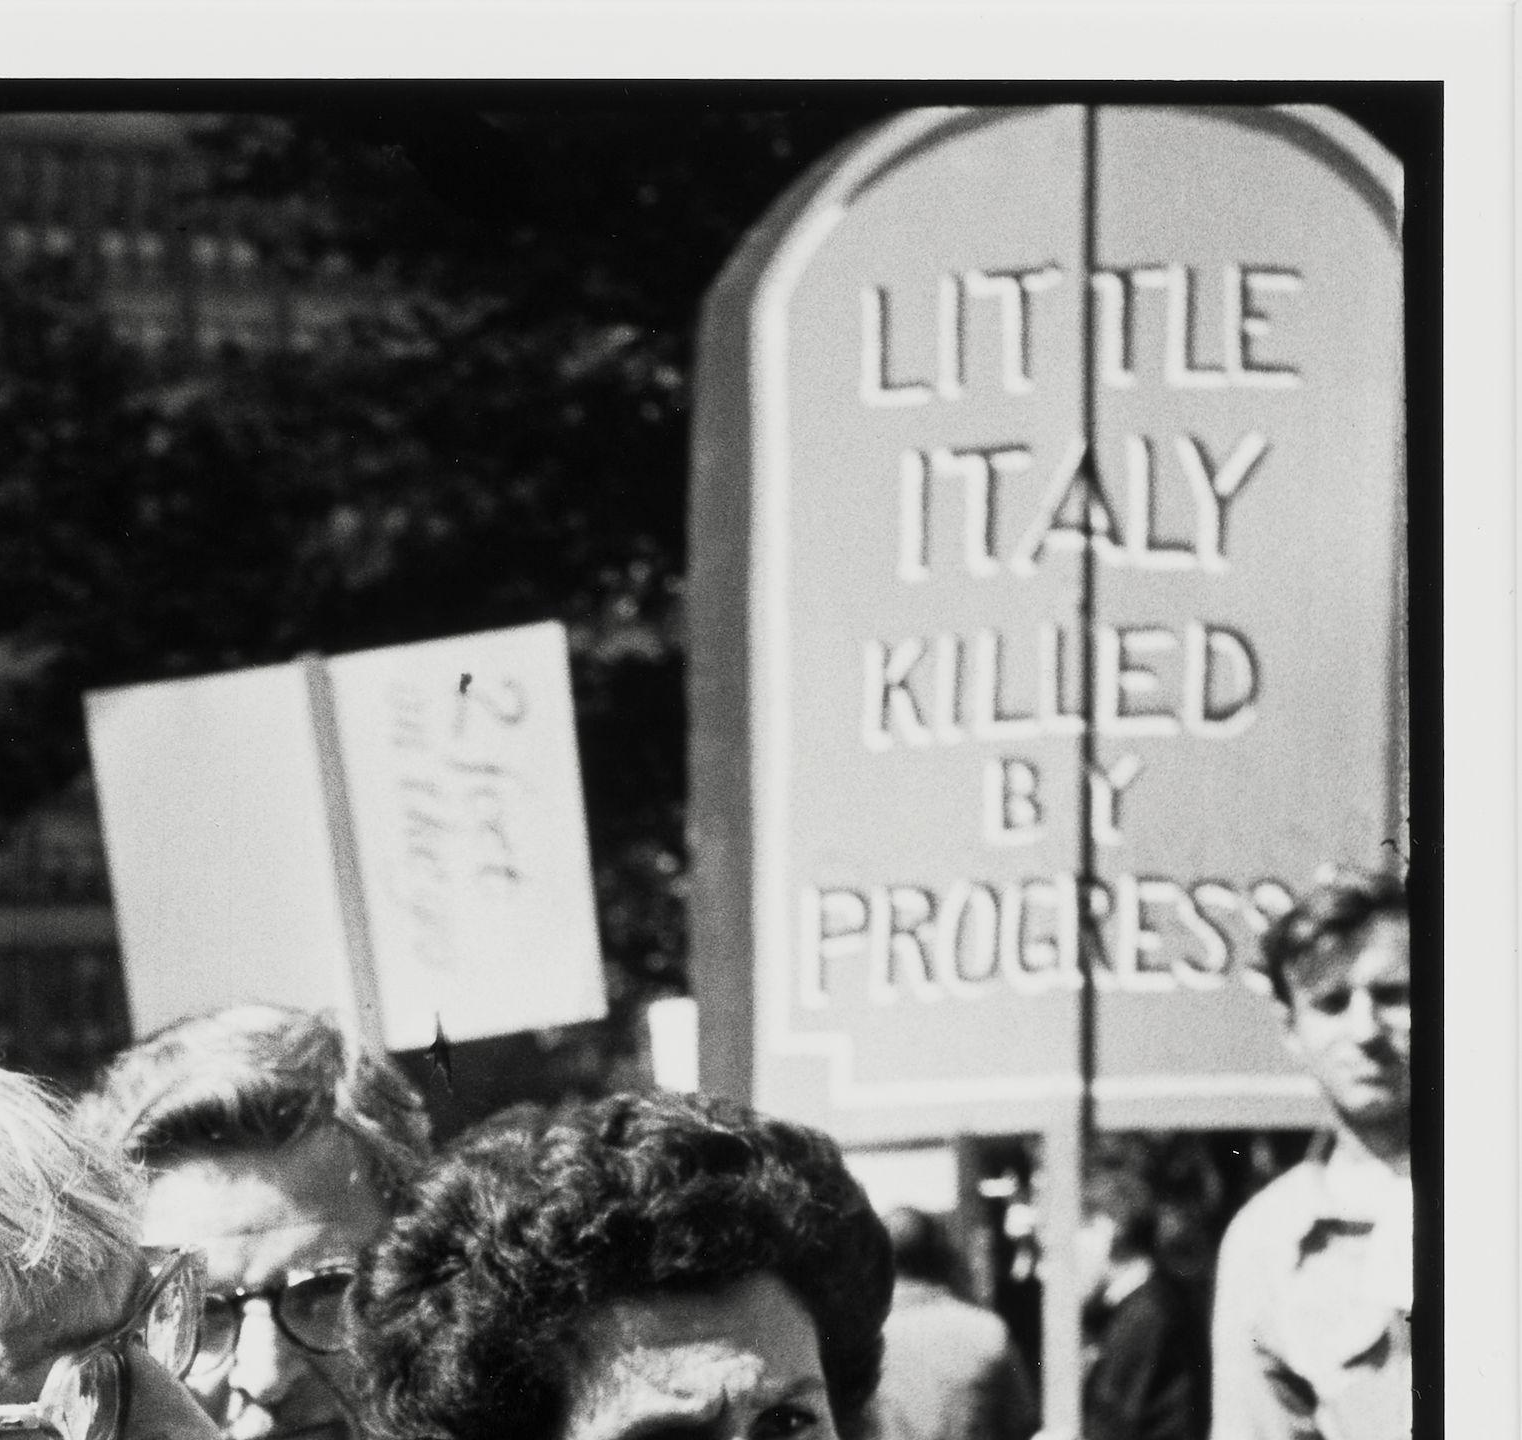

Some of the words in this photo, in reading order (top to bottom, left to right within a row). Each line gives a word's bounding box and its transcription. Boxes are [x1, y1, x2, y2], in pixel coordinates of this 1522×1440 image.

[859, 260, 1303, 403] LITTLE
[897, 432, 1270, 582] ITALY
[862, 620, 1262, 750] KILLED
[986, 755, 1147, 846] BY
